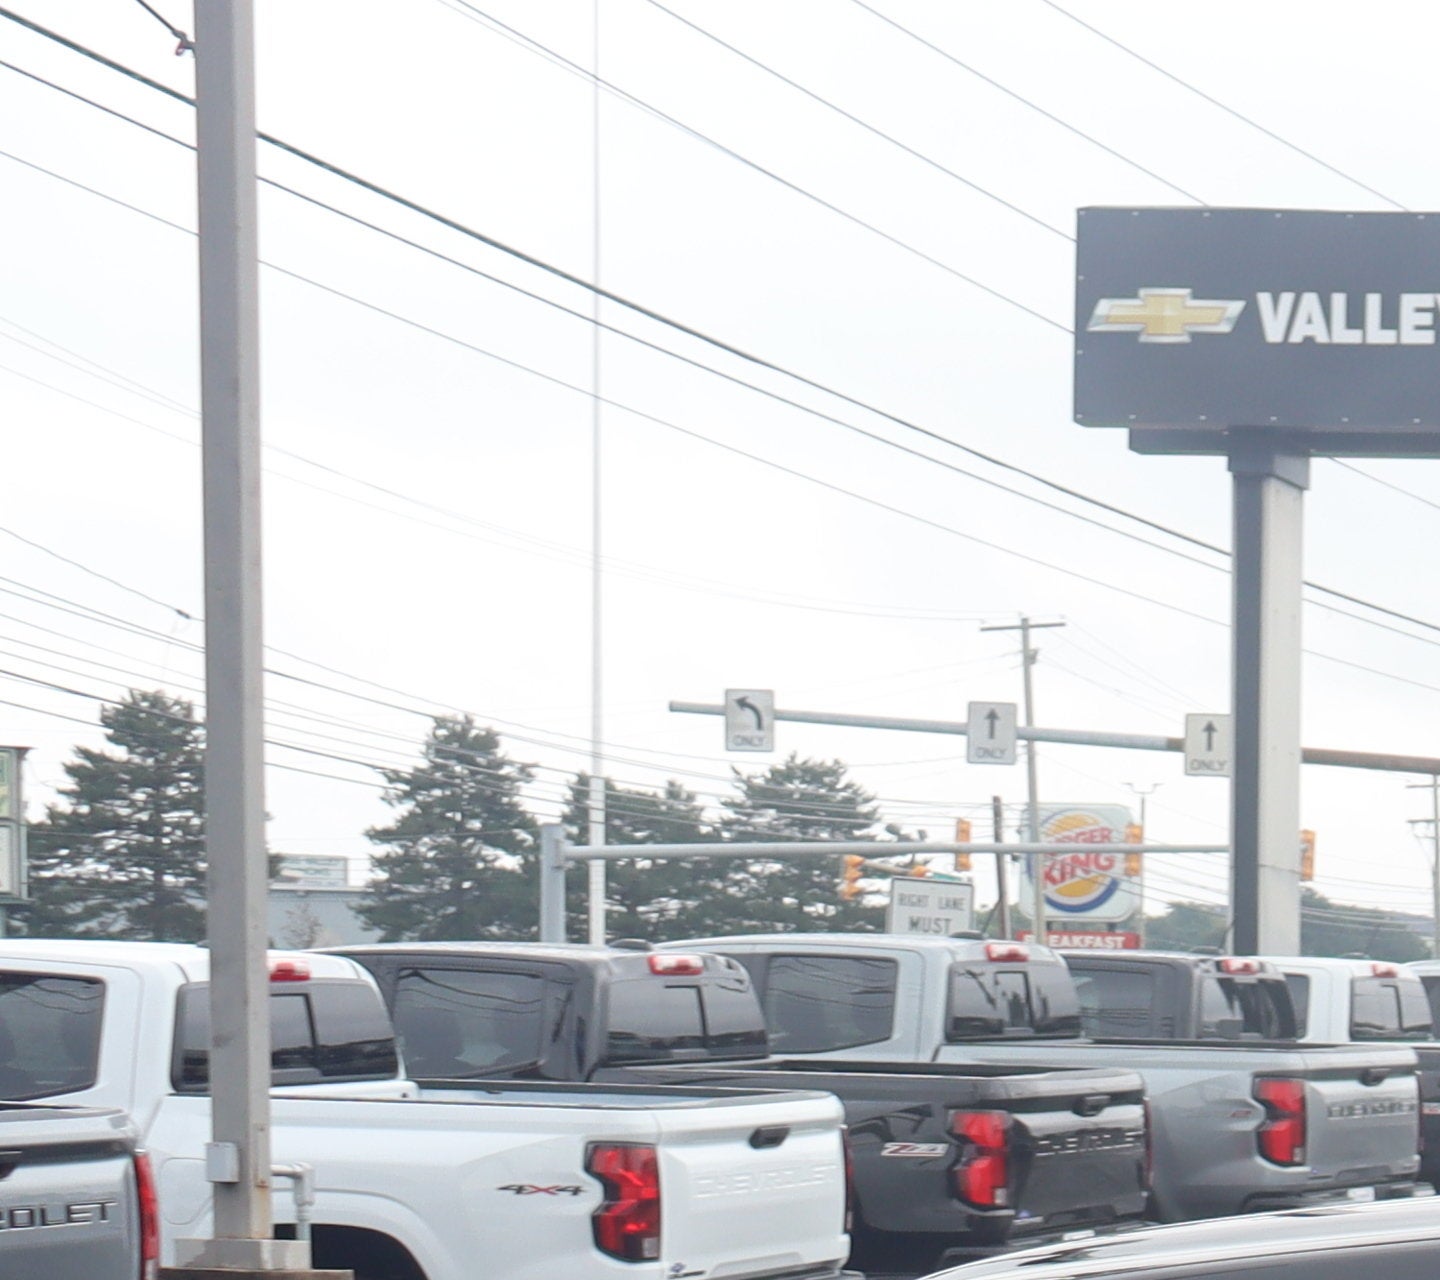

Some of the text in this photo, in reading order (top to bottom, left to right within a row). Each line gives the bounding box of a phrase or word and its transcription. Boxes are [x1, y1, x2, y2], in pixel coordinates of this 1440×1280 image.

[732, 734, 766, 747] ONLY
[975, 747, 1006, 760] ONLY
[1189, 758, 1228, 771] ONLY
[1043, 852, 1115, 888] KING
[898, 892, 966, 912] RIGHT LANE
[908, 915, 952, 934] MUST
[0, 1200, 118, 1231] OLET
